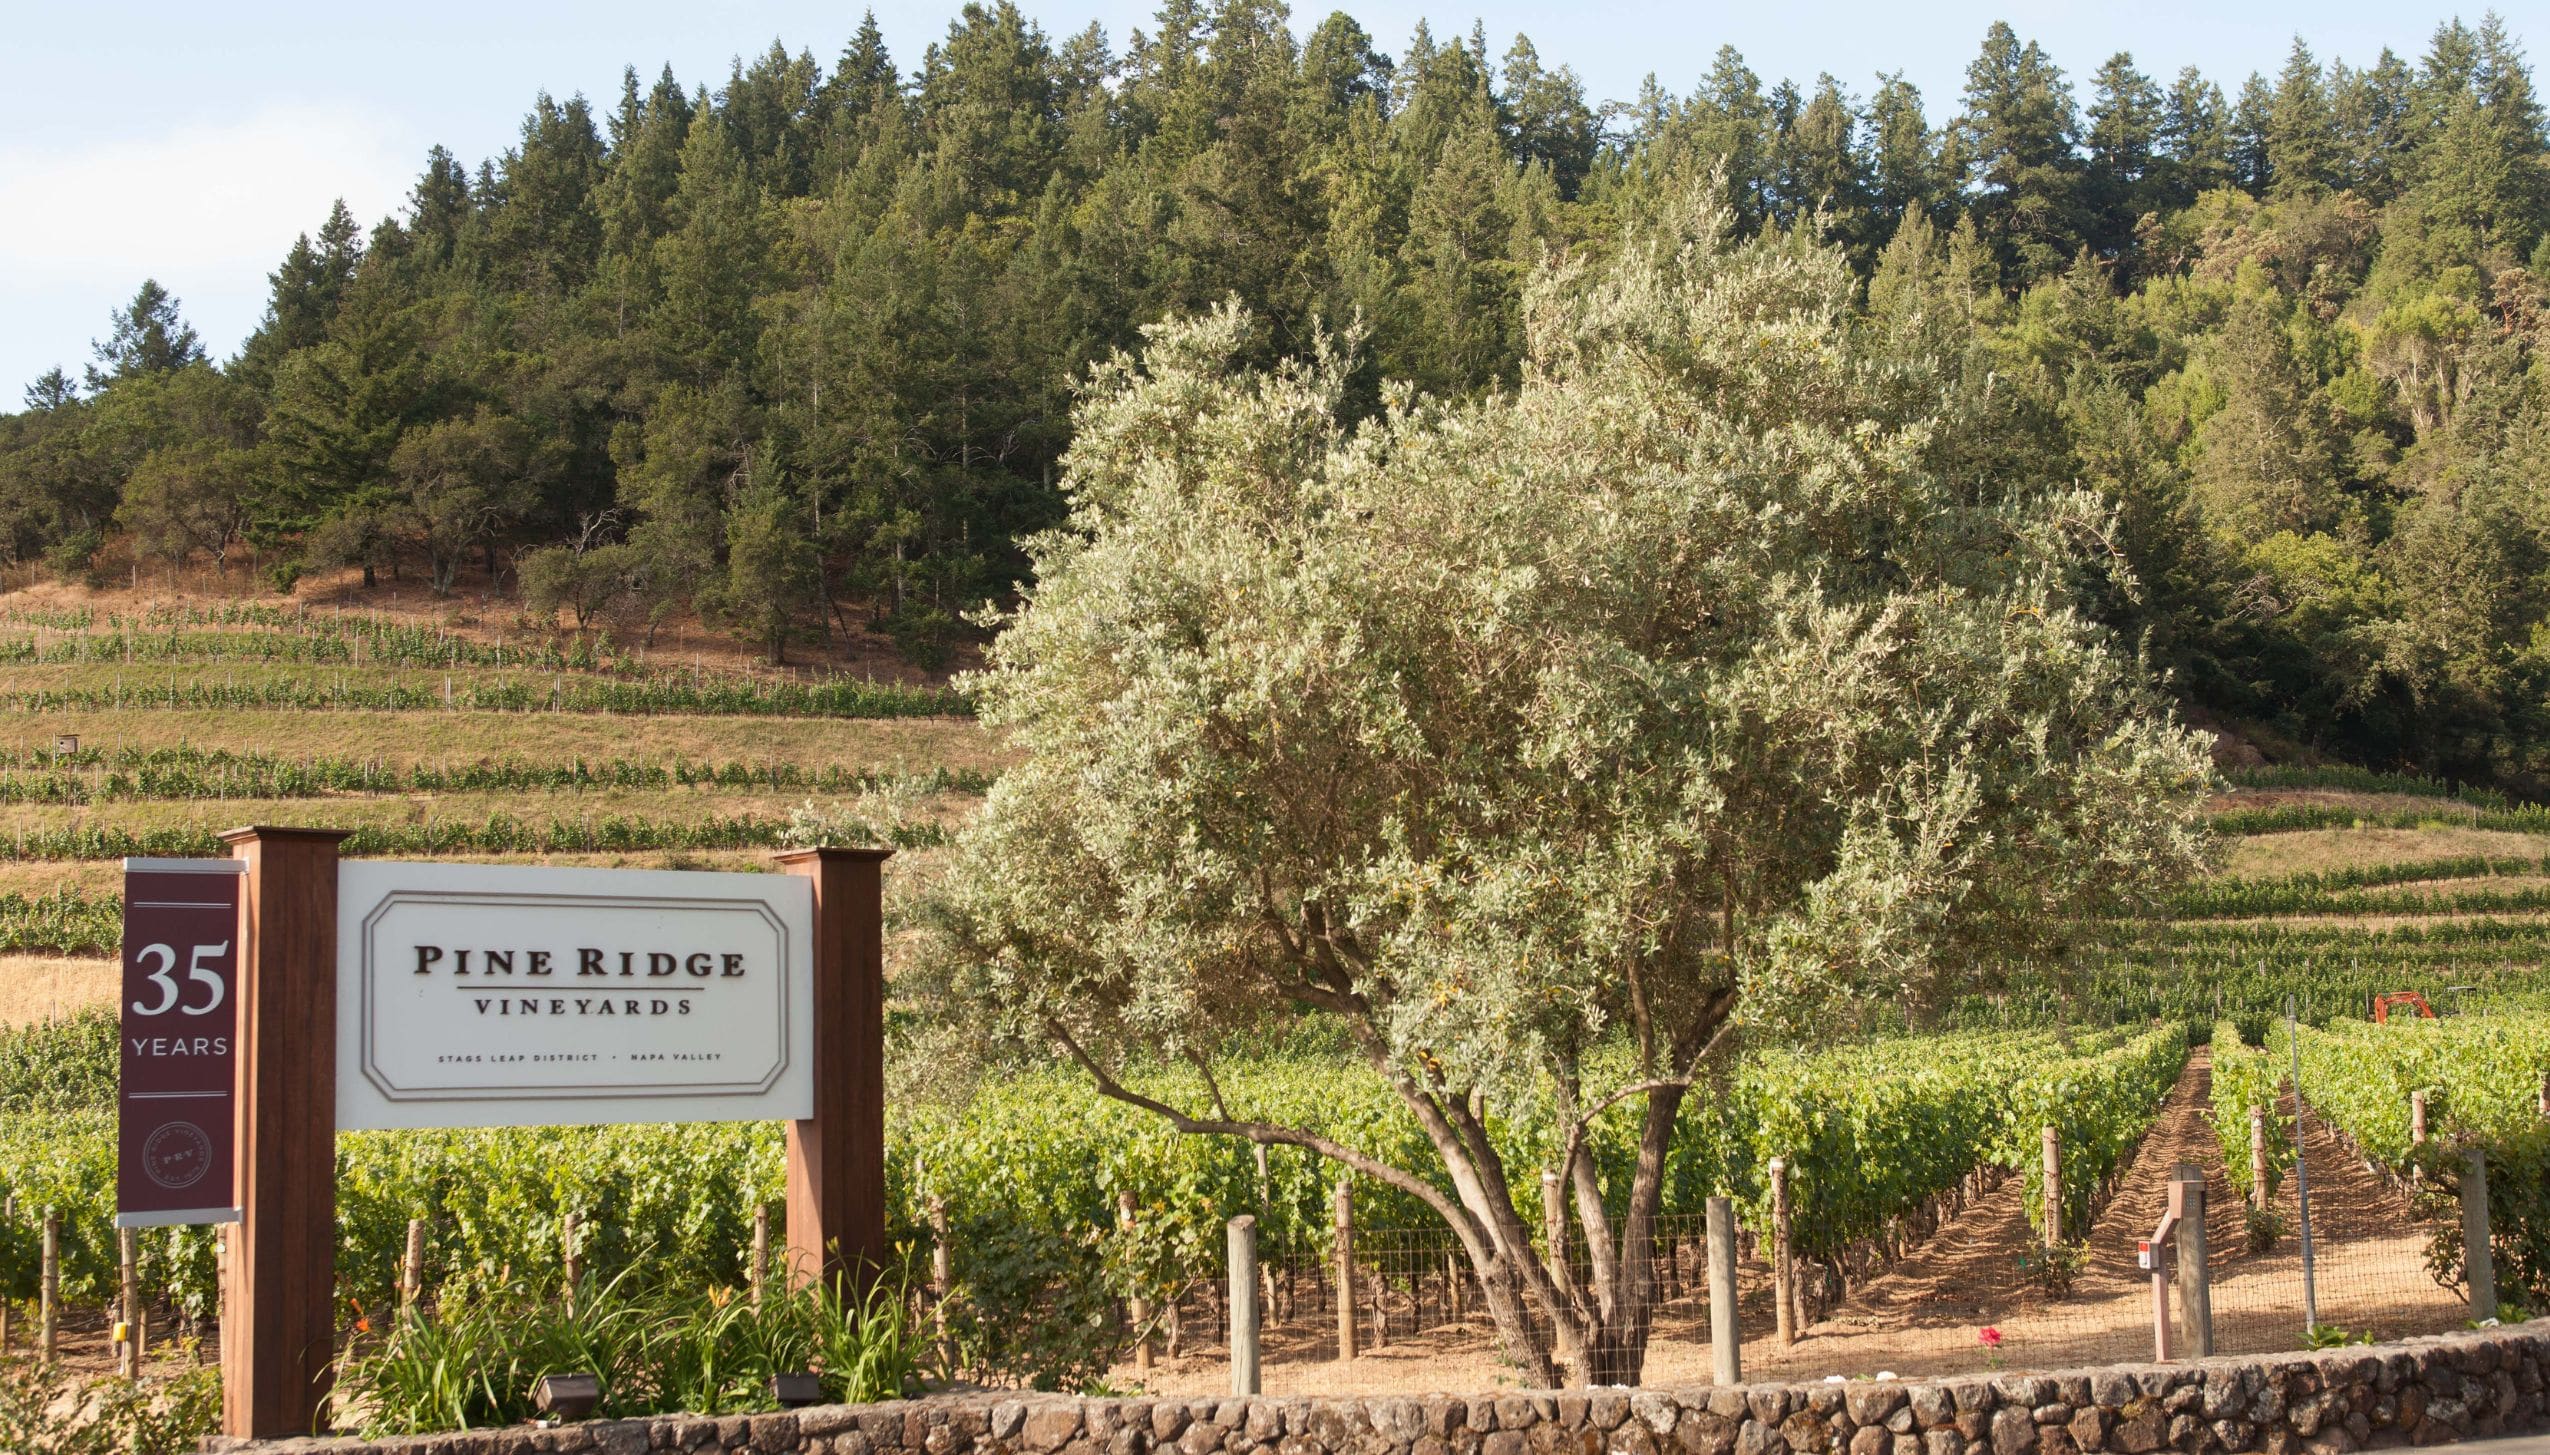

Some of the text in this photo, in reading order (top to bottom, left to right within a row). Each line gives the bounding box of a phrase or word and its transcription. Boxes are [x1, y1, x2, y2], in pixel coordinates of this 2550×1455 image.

[413, 945, 746, 978] PINE RIDGE
[131, 939, 230, 1016] 35
[473, 998, 692, 1016] VINEYARDS
[131, 1037, 228, 1057] YEARS
[438, 1053, 722, 1064] STAGS LEAP DISTRICT NAPA VALLEY
